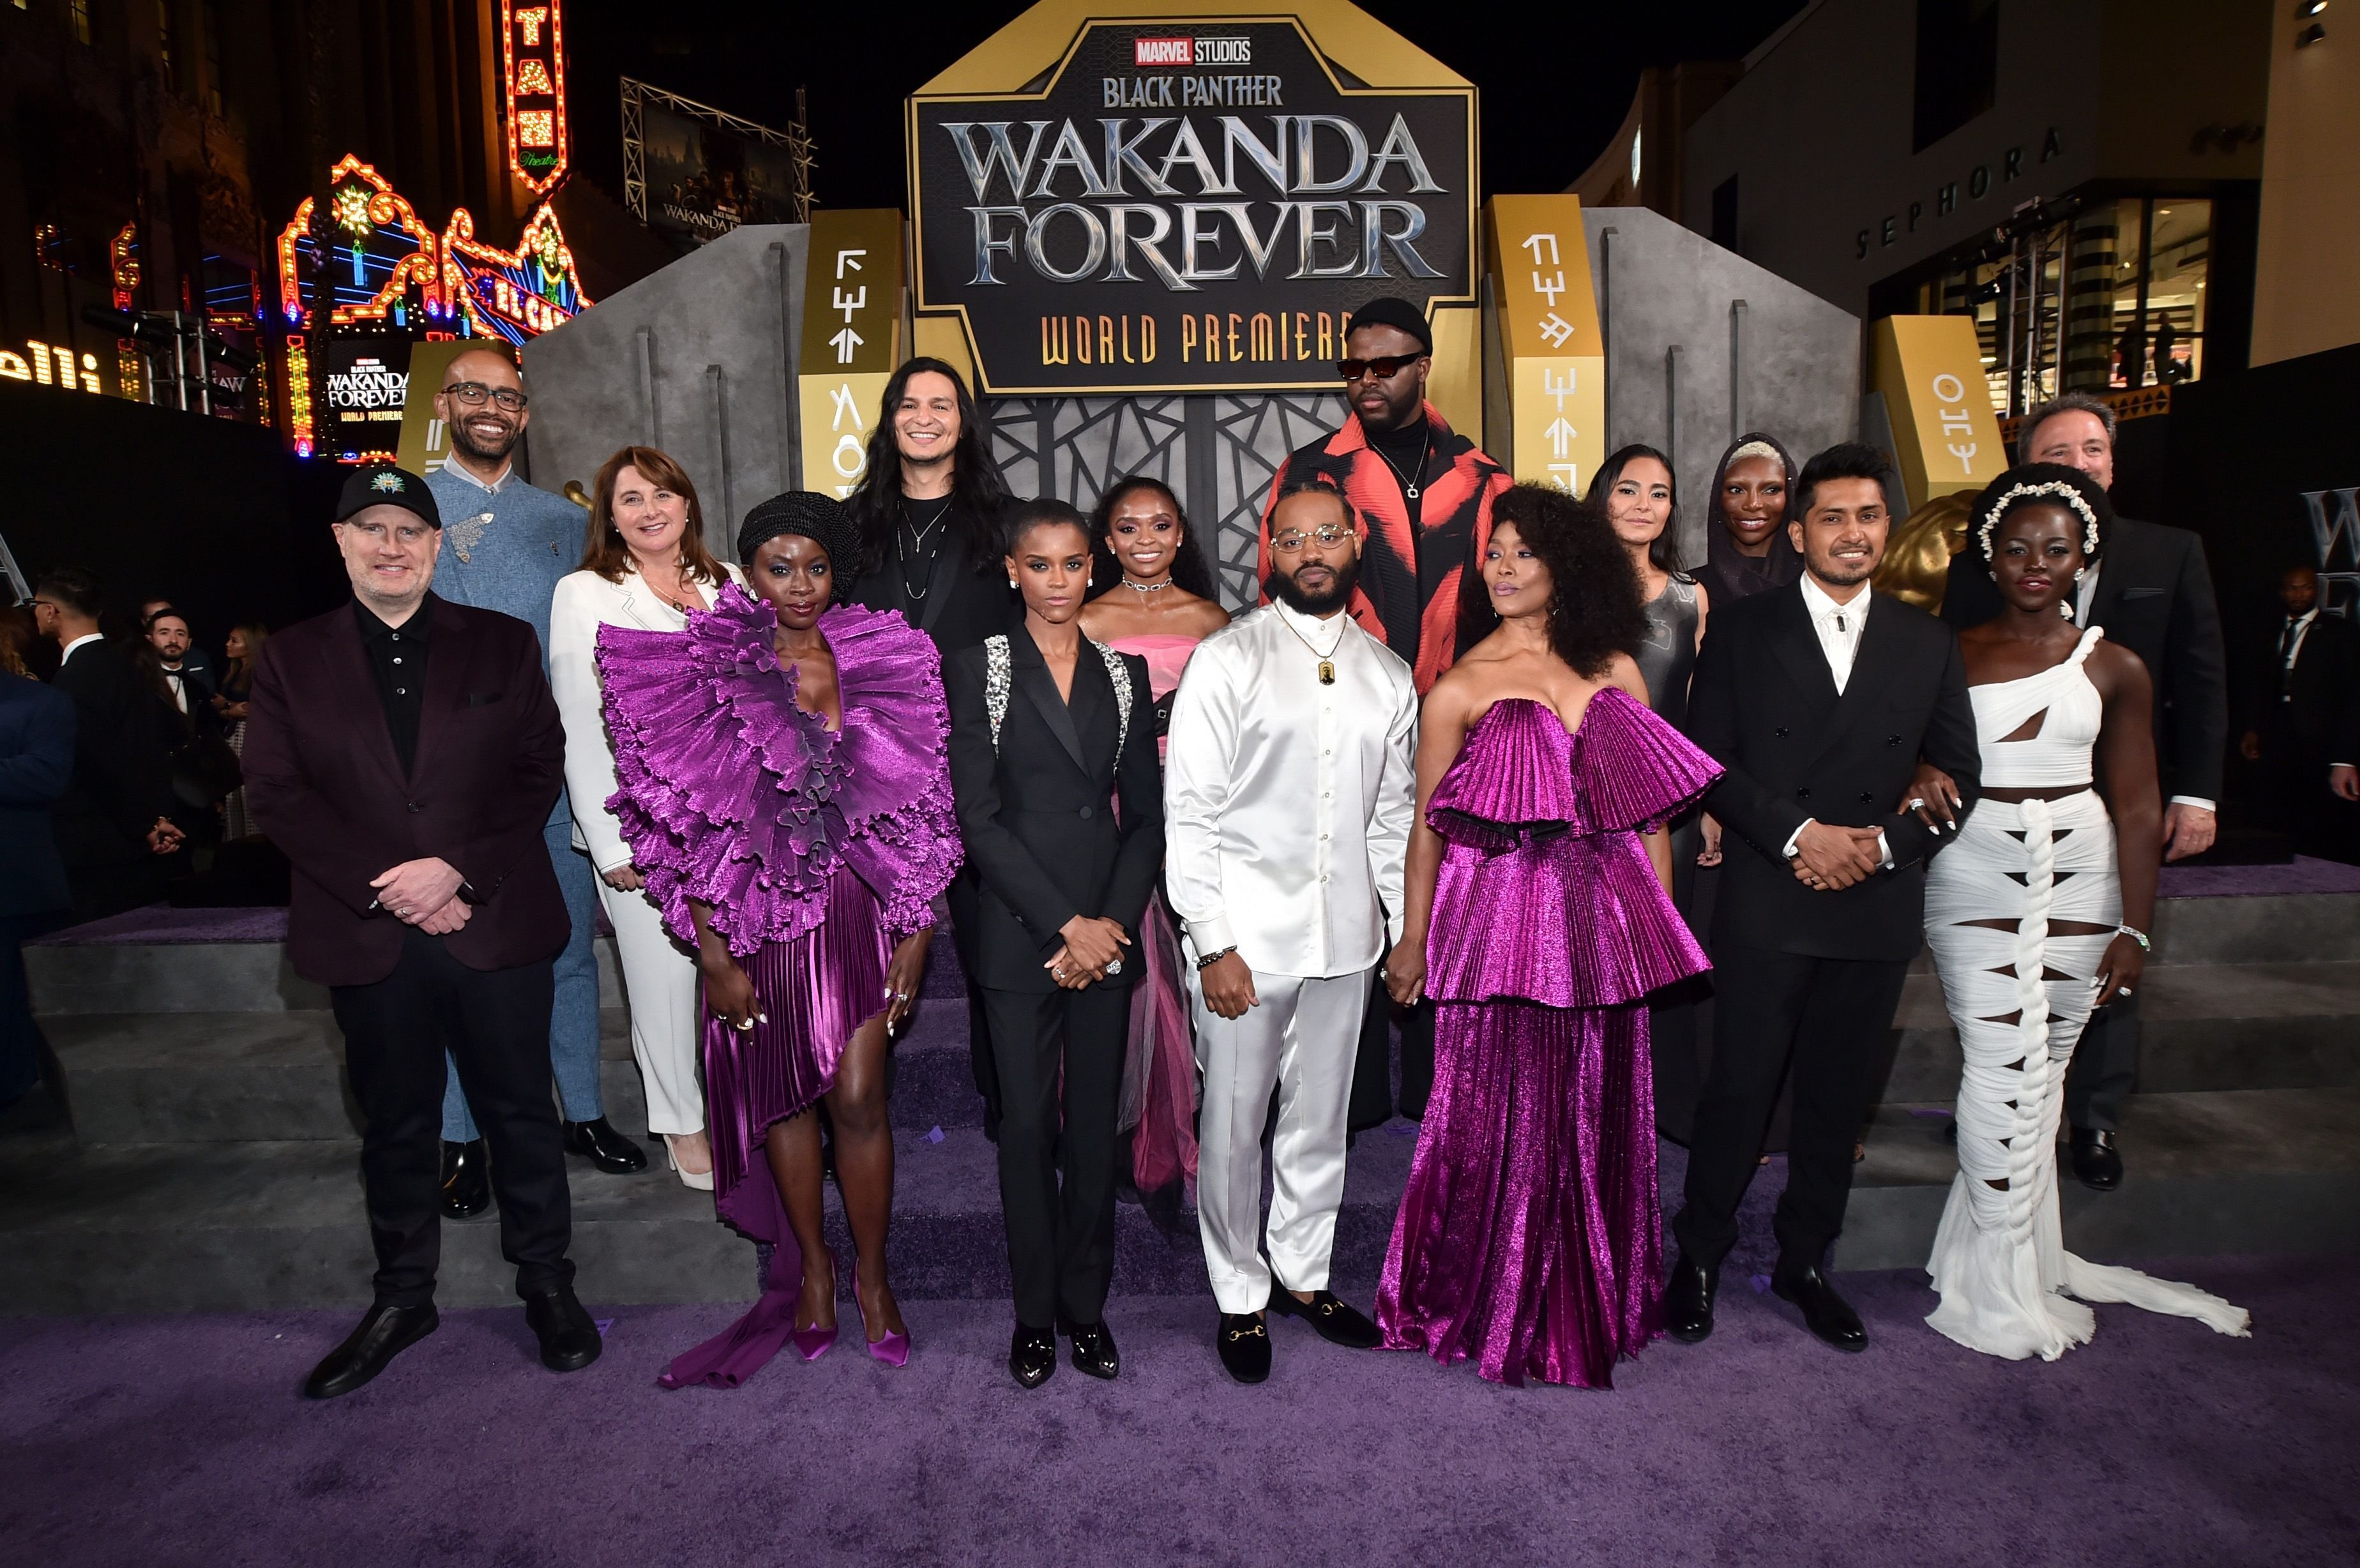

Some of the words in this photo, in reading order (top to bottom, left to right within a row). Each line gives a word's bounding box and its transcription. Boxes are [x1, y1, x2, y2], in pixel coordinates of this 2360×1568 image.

[1137, 41, 1191, 63] MARVEL
[1195, 40, 1251, 62] STUDIOS
[1102, 76, 1176, 108] BLACK
[1182, 75, 1283, 108] PANTHER
[519, 151, 560, 167] Theatre
[938, 112, 1449, 206] WAKANDA
[1855, 126, 2061, 260] SEPHORA
[663, 203, 727, 232] WAKANDA
[963, 199, 1449, 291] FOREVER
[1041, 313, 1156, 365] WORLD
[341, 412, 365, 421] WORLD
[368, 411, 403, 421] PREMIERE
